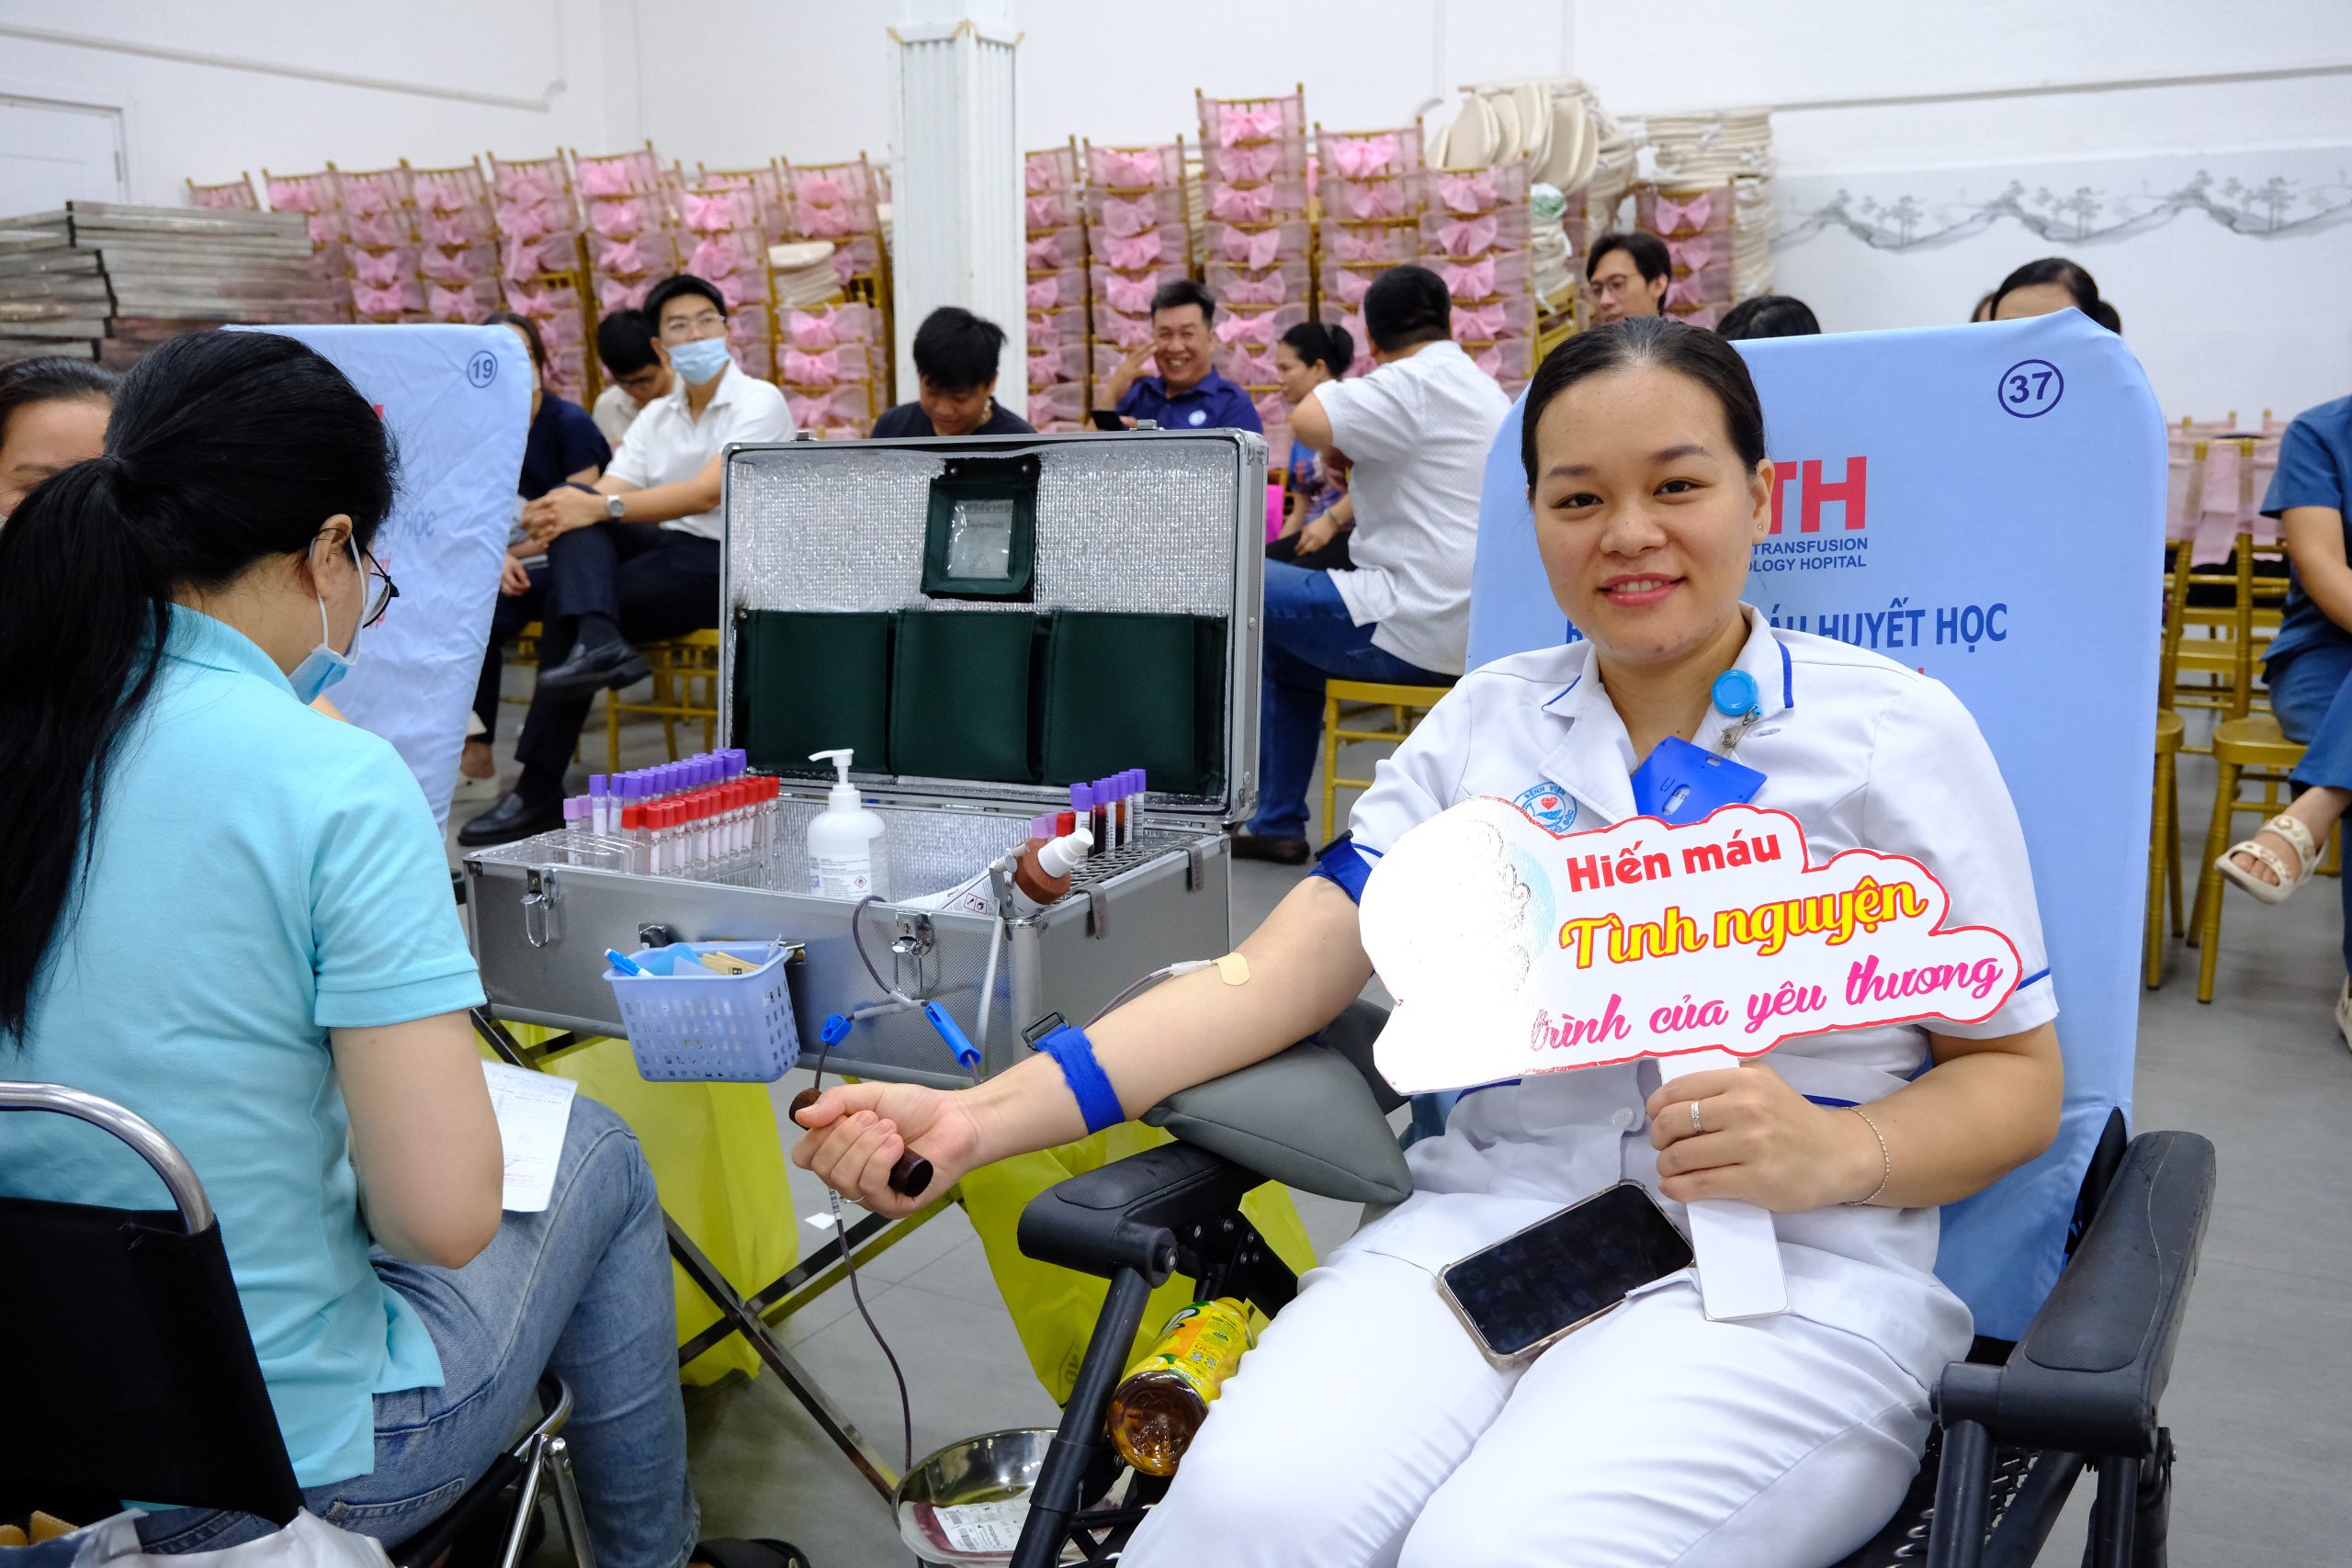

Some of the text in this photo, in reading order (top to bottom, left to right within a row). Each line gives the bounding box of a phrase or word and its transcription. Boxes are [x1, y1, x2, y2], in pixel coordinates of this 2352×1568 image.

[472, 359, 493, 379] 19
[2008, 371, 2052, 403] 37
[1749, 555, 1867, 572] LOGY HOPITAL
[1752, 537, 1868, 556] TRANSFUSION
[1818, 597, 1926, 649] HUYẾT
[1936, 603, 2007, 652] HỌC
[1566, 829, 1781, 893] Hiến máu
[1559, 875, 1929, 969] Tình nguyện
[1649, 993, 1728, 1034] của
[1744, 980, 1826, 1033] yêu
[1846, 954, 2004, 1005] thương
